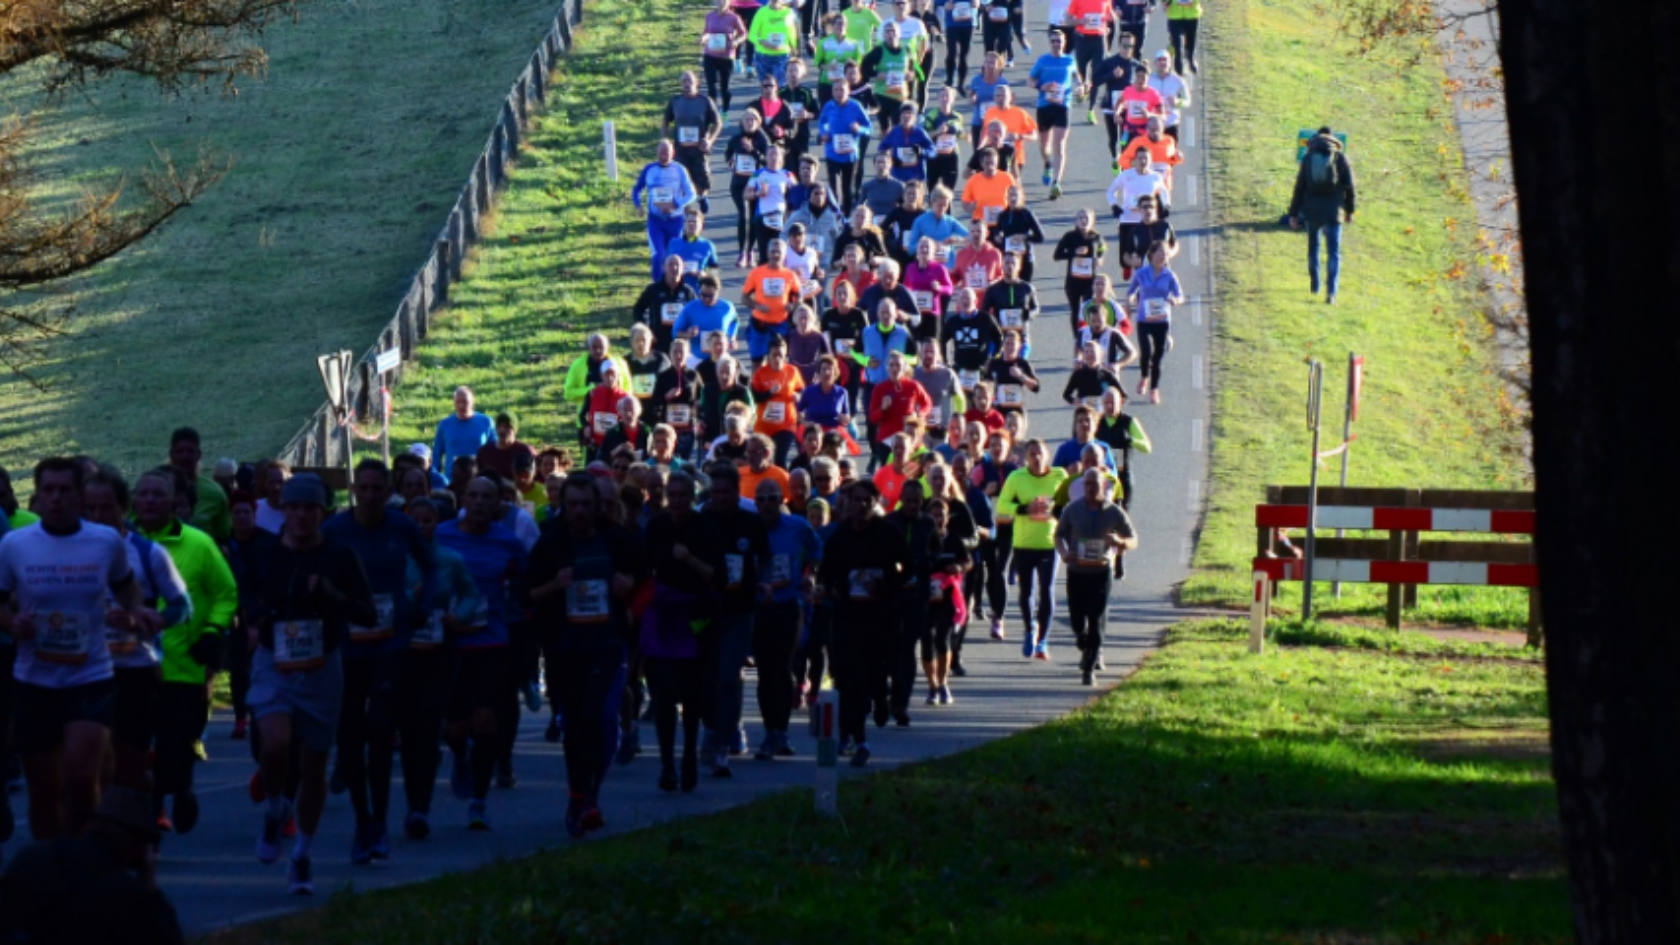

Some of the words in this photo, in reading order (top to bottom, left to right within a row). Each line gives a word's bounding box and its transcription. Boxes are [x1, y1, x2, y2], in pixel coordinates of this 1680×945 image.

[25, 564, 57, 573] ECHTE
[27, 575, 62, 585] GEVEN
[64, 575, 99, 584] BLOED
